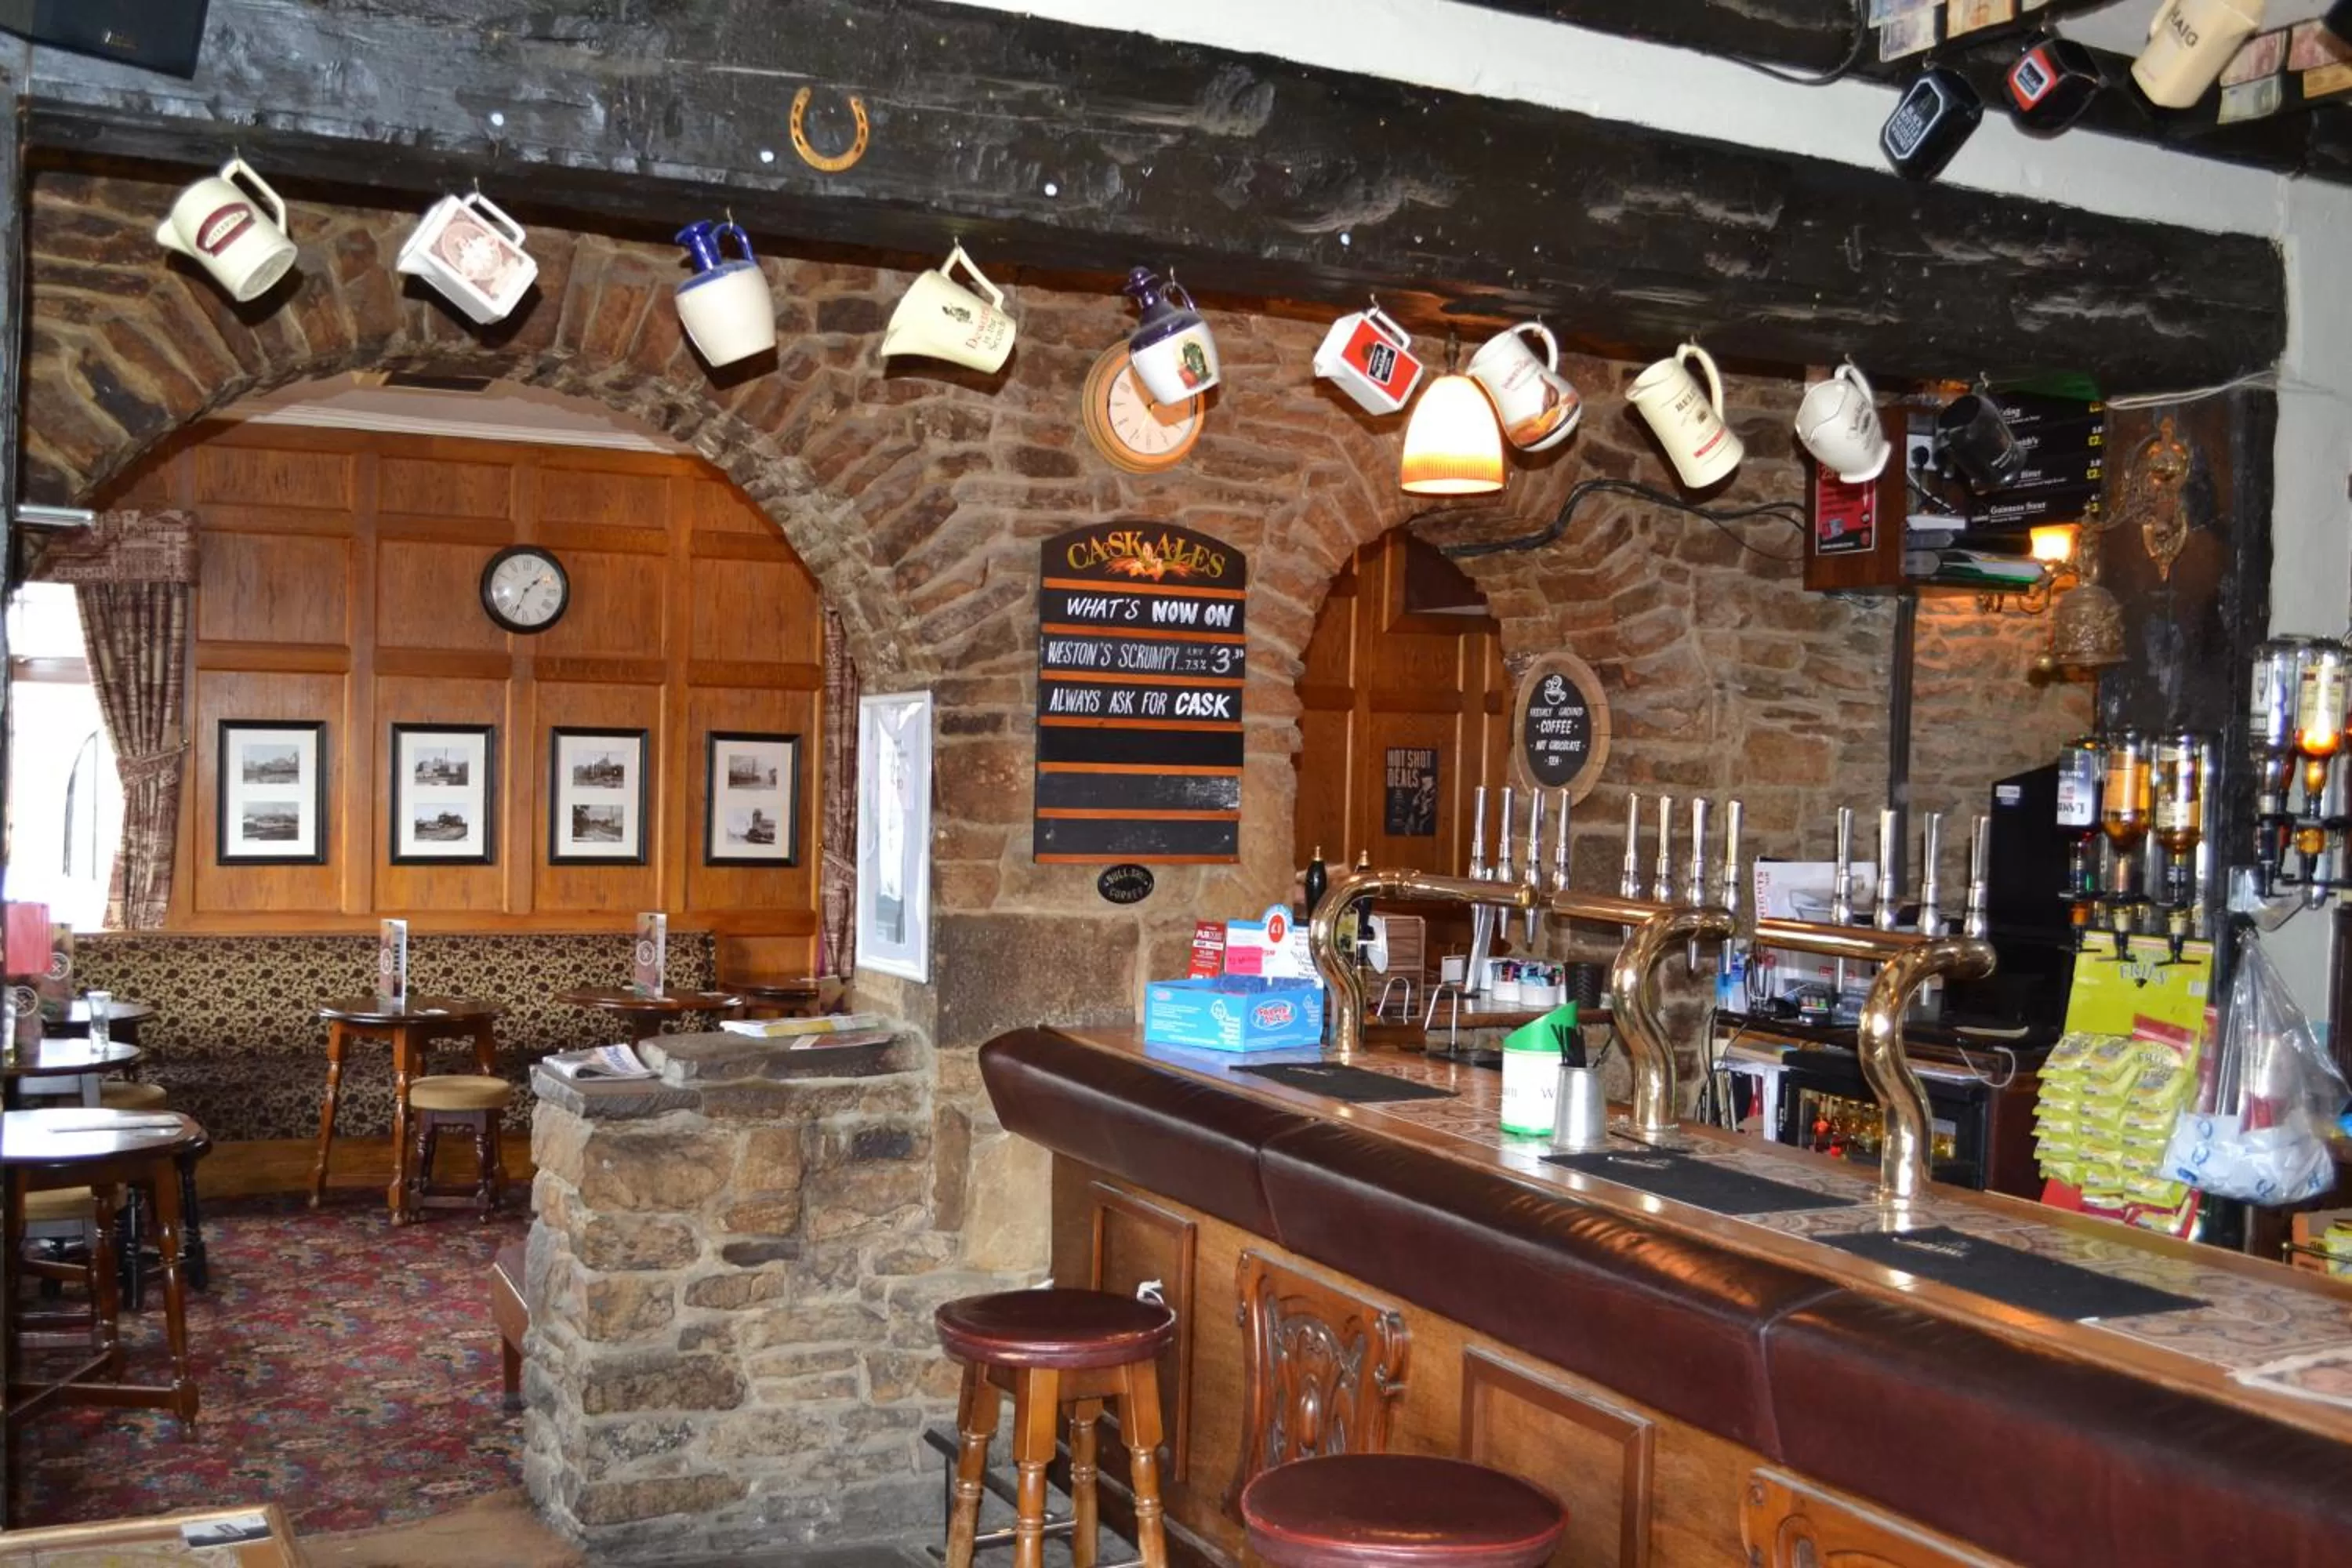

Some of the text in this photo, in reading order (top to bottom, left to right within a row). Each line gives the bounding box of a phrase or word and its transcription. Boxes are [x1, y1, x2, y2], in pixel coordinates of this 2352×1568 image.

[1067, 531, 1225, 578] CASK ALES
[1067, 597, 1234, 627] WHAT'S NOW ON
[1047, 641, 1113, 666] WESTON'S
[1049, 688, 1230, 718] ALWAYS ASK FOR CASK
[1540, 720, 1573, 734] COFFEE
[1387, 750, 1431, 768] HOT SHOT
[1387, 768, 1418, 788] DEALS
